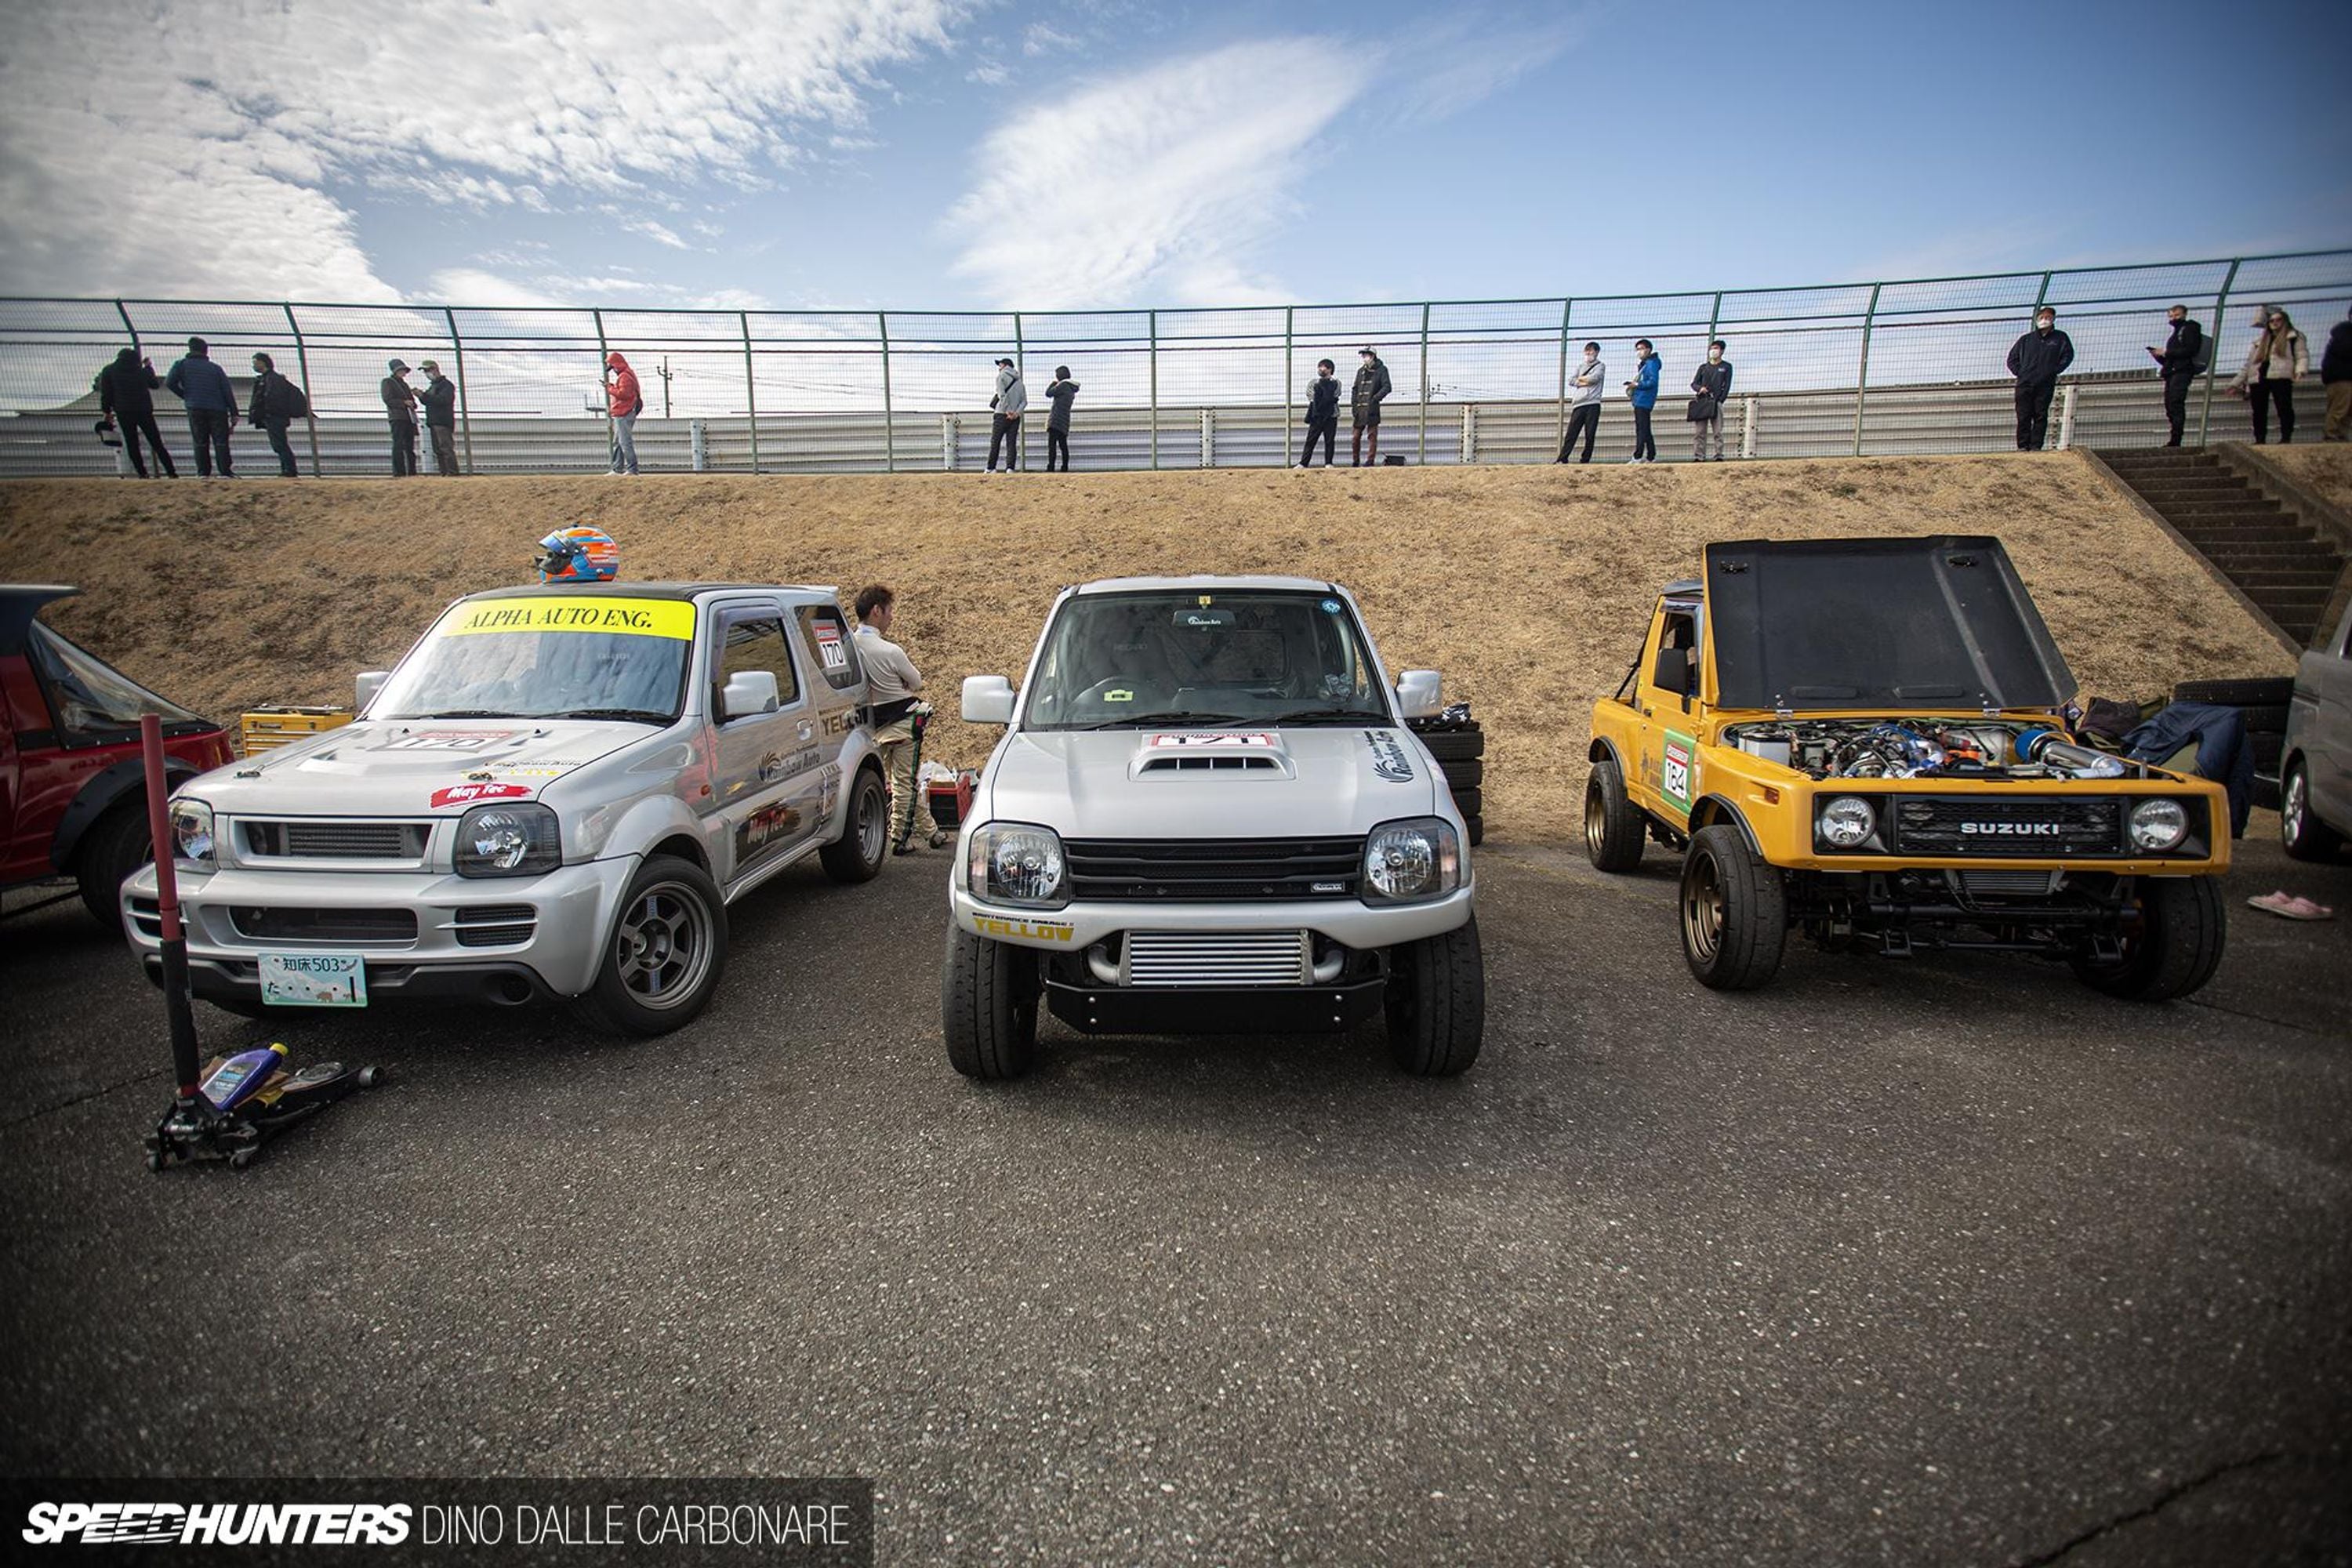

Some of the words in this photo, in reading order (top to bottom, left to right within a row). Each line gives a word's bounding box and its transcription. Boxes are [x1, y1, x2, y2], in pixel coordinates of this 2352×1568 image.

[466, 608, 531, 628] ALPHA
[538, 608, 600, 626] AUTO
[601, 609, 652, 628] ENG.
[822, 642, 844, 666] 170
[446, 786, 480, 800] May
[1960, 822, 2060, 836] SUZUKI
[973, 916, 1075, 942] YELLOW
